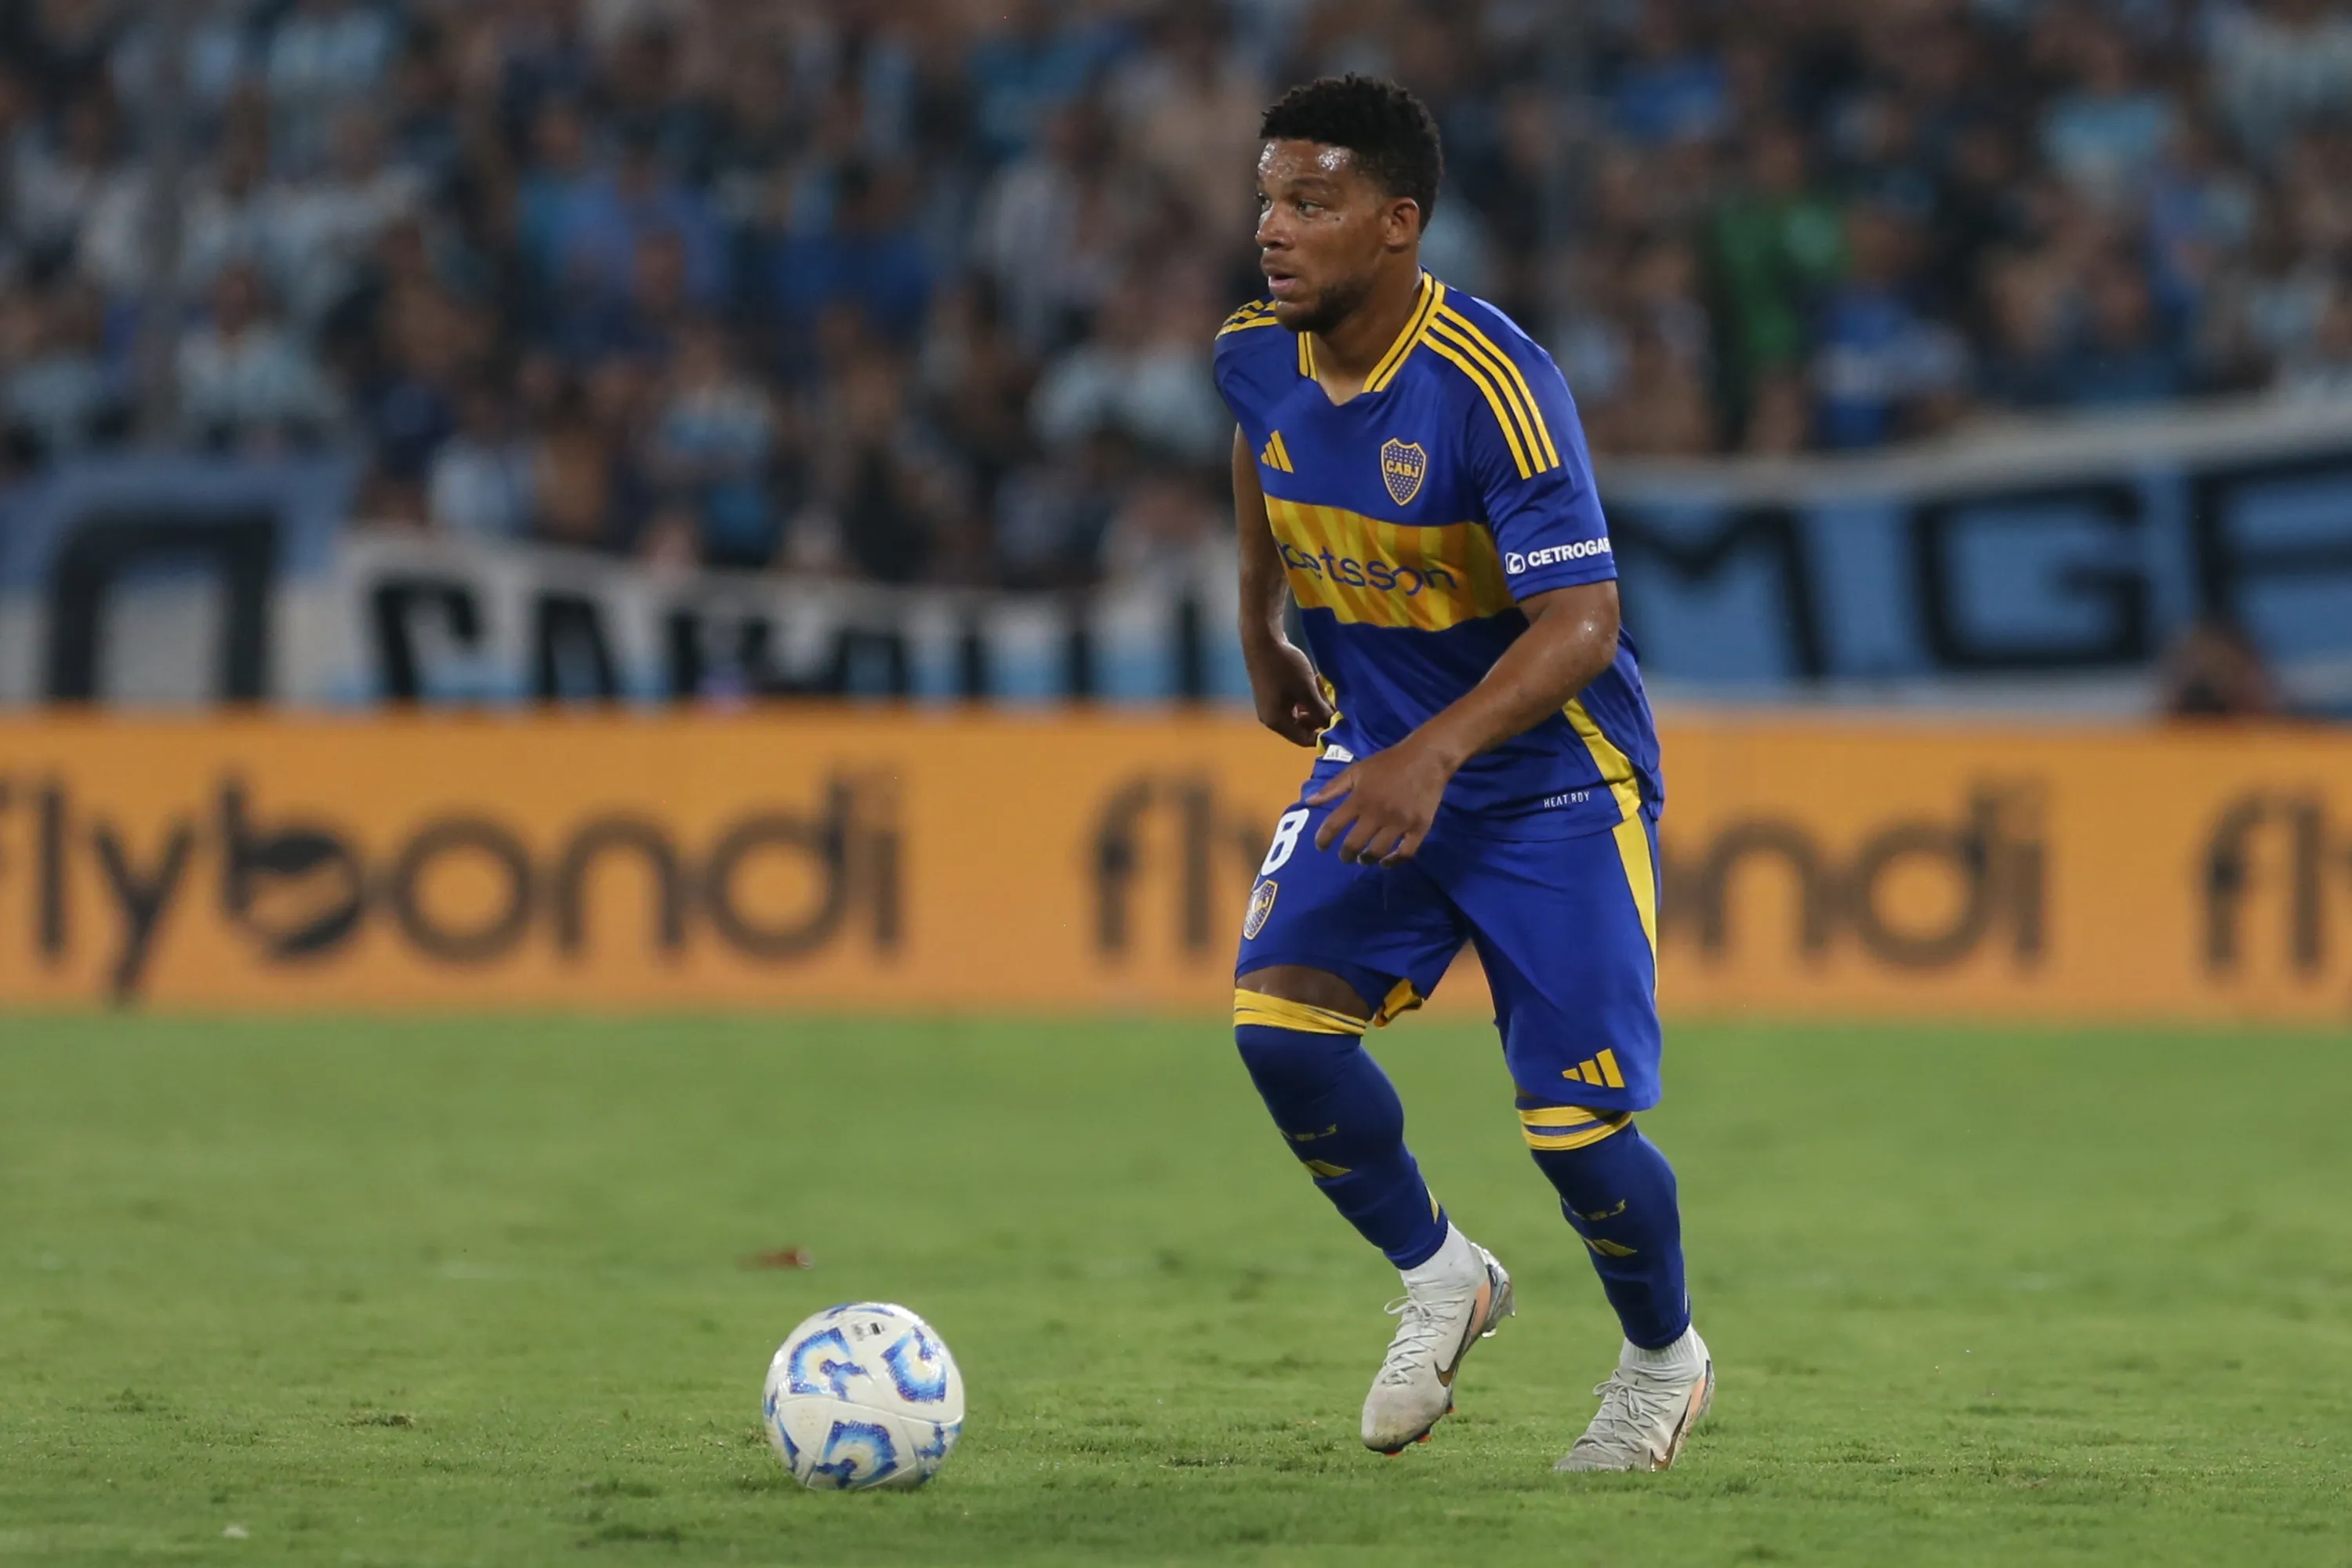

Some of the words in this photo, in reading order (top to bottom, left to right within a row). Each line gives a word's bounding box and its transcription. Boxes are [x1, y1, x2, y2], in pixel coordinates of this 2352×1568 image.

[1386, 460, 1420, 477] CABJ
[1261, 808, 1309, 877] 8
[0, 778, 903, 1007] lybondi
